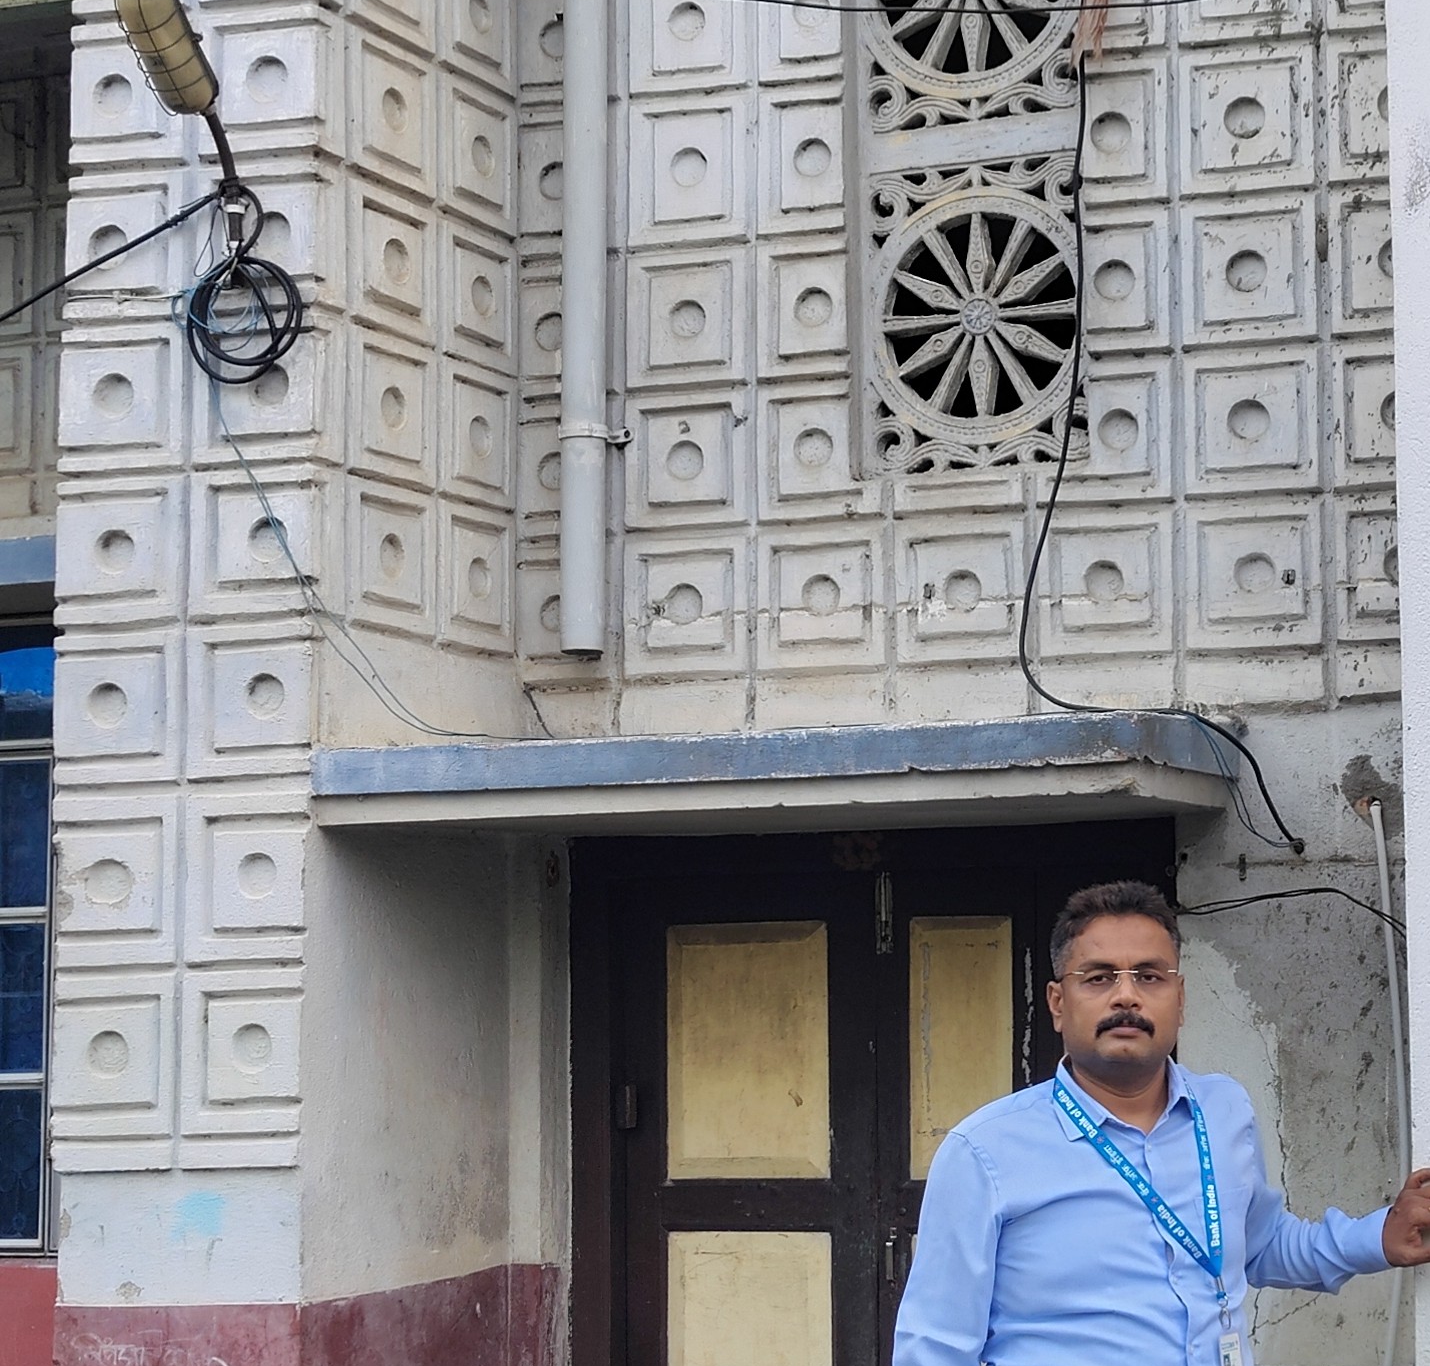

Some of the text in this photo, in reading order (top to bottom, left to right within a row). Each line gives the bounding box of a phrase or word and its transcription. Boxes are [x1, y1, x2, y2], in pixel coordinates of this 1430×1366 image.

[1058, 1089, 1098, 1138] Bank of India
[1157, 1204, 1202, 1259] Bank of India
[1206, 1185, 1220, 1247] Bank of India
